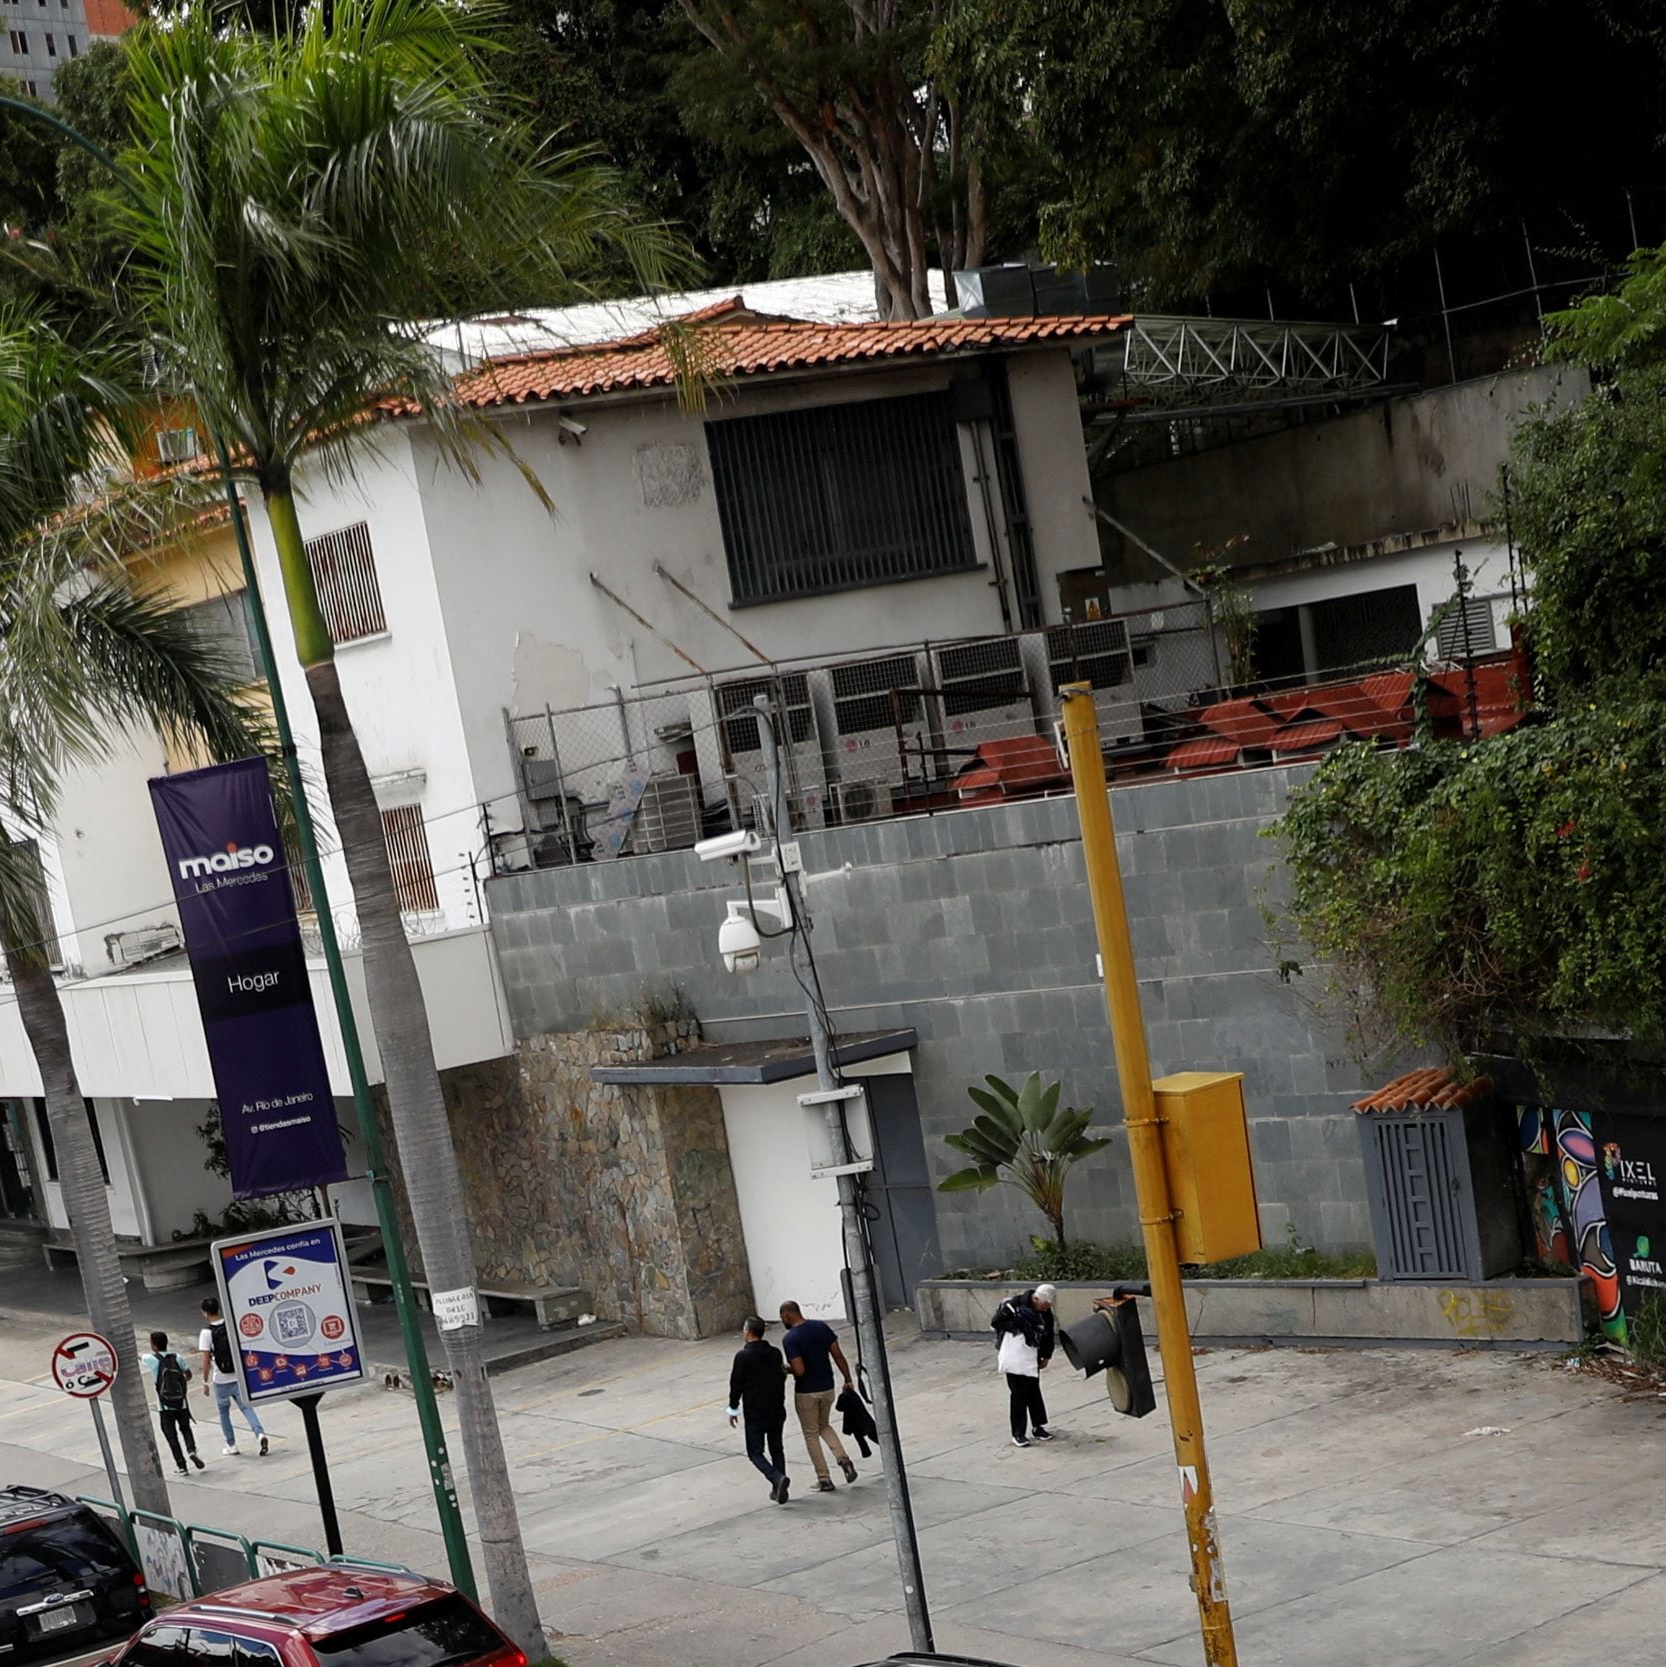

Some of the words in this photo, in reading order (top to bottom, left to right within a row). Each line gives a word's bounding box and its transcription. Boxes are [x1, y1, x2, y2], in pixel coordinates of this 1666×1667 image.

[178, 840, 274, 880] maiso
[195, 882, 214, 894] Las
[217, 871, 269, 889] Mercedes
[228, 972, 280, 993] Hogar
[242, 1104, 255, 1115] Av.
[271, 1098, 283, 1109] de
[284, 1092, 314, 1106] Janeiro
[235, 1253, 248, 1262] Las
[249, 1247, 286, 1259] Mercedes
[248, 1284, 322, 1307] DEEPCOMPANY
